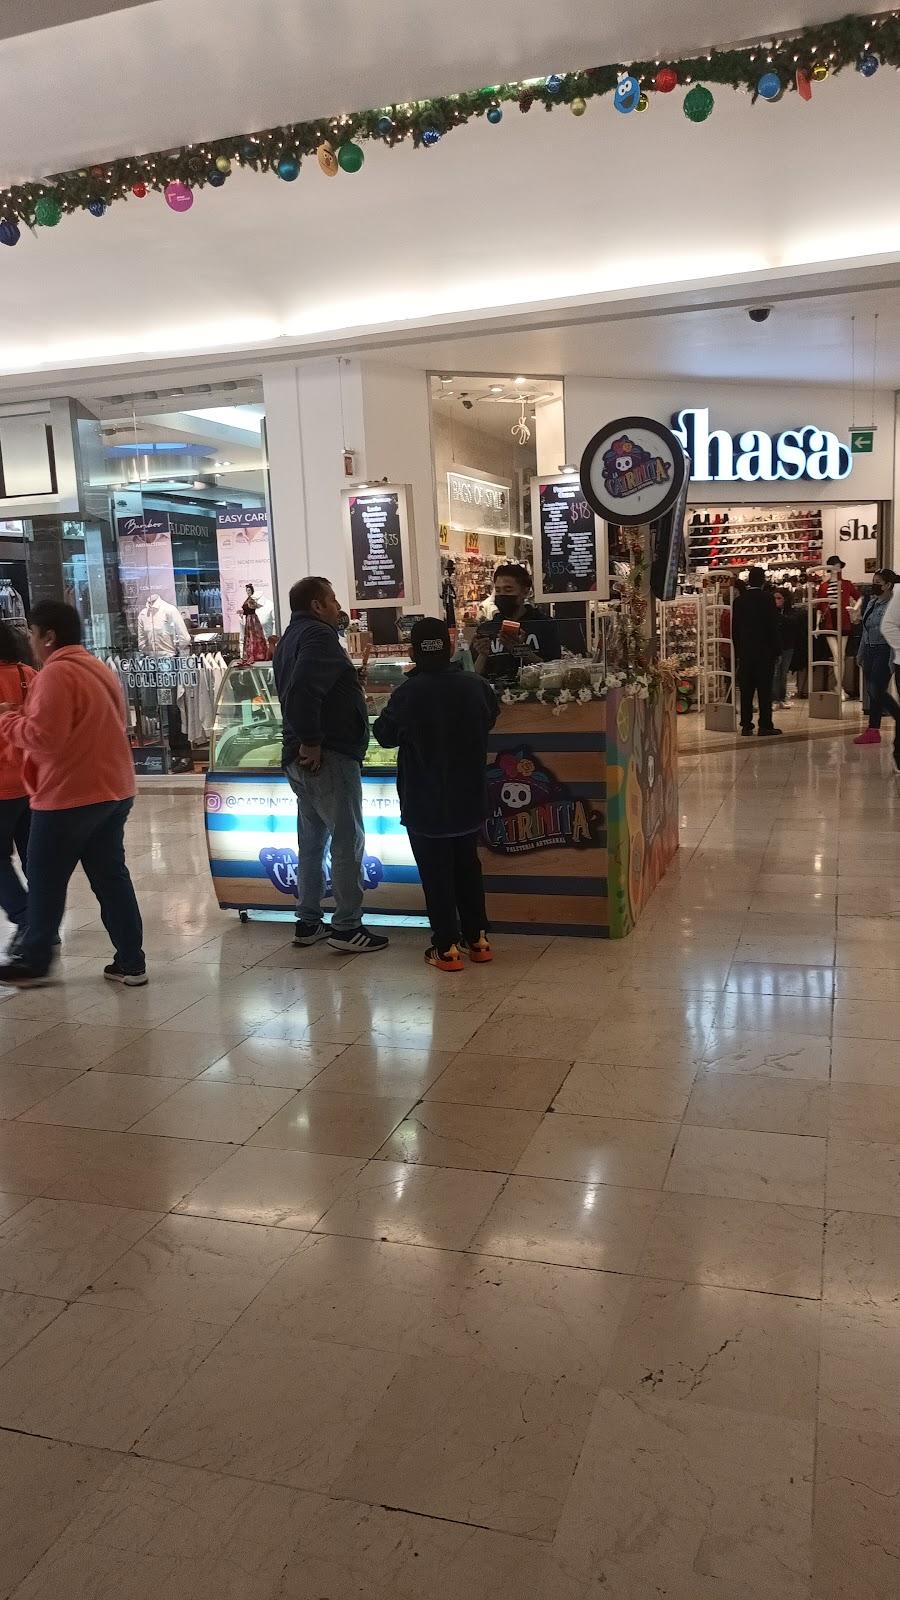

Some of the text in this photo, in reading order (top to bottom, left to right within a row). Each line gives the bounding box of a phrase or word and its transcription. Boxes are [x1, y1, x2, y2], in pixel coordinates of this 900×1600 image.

[218, 512, 242, 524] EASY
[169, 522, 209, 537] ALDERONI
[128, 671, 198, 688] COLLECTION
[283, 854, 293, 863] LA
